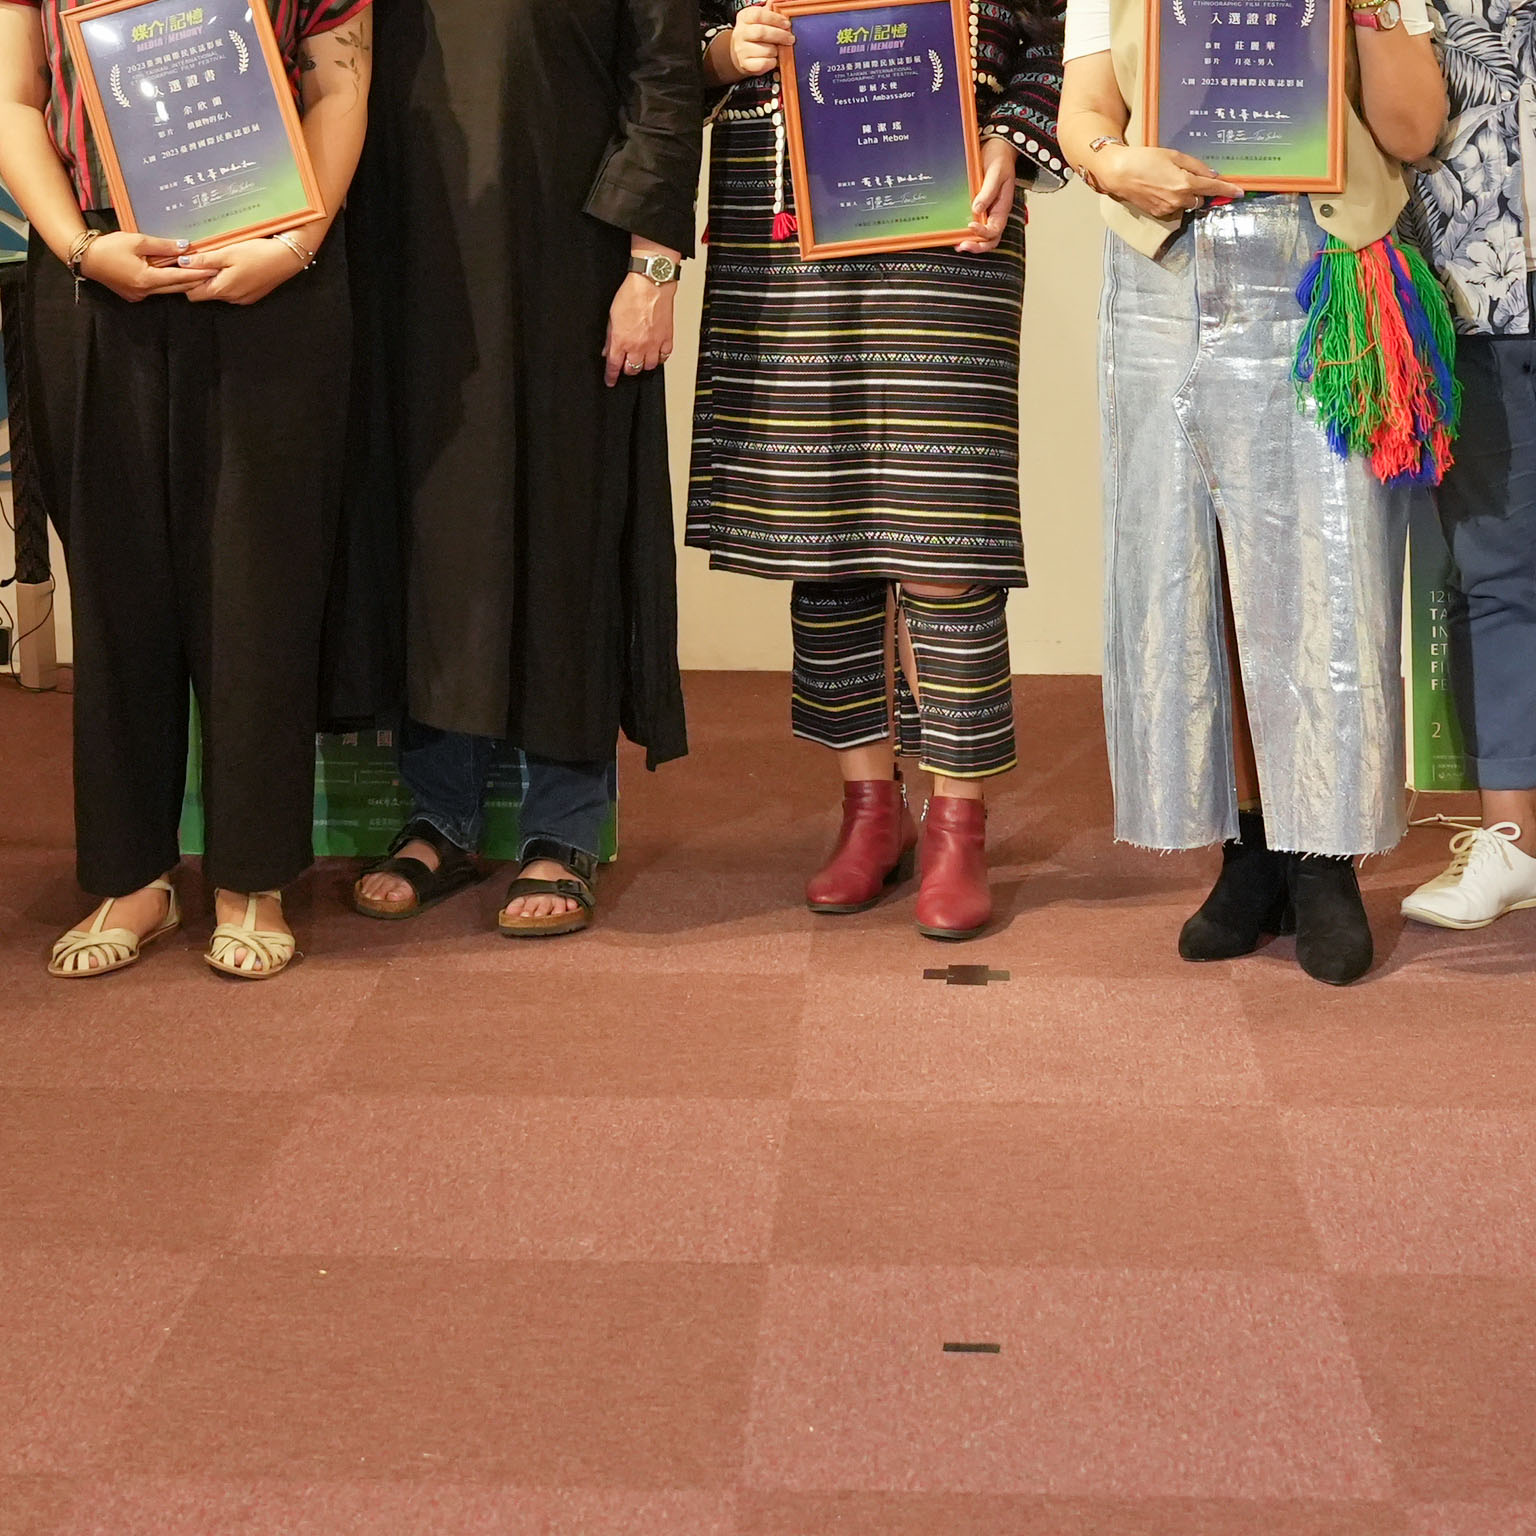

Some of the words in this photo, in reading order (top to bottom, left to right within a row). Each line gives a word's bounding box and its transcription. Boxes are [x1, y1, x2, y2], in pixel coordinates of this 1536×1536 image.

[834, 95, 868, 105] Festival
[872, 92, 915, 101] Ambassador
[858, 137, 878, 145] Laha
[883, 134, 909, 143] Mebow
